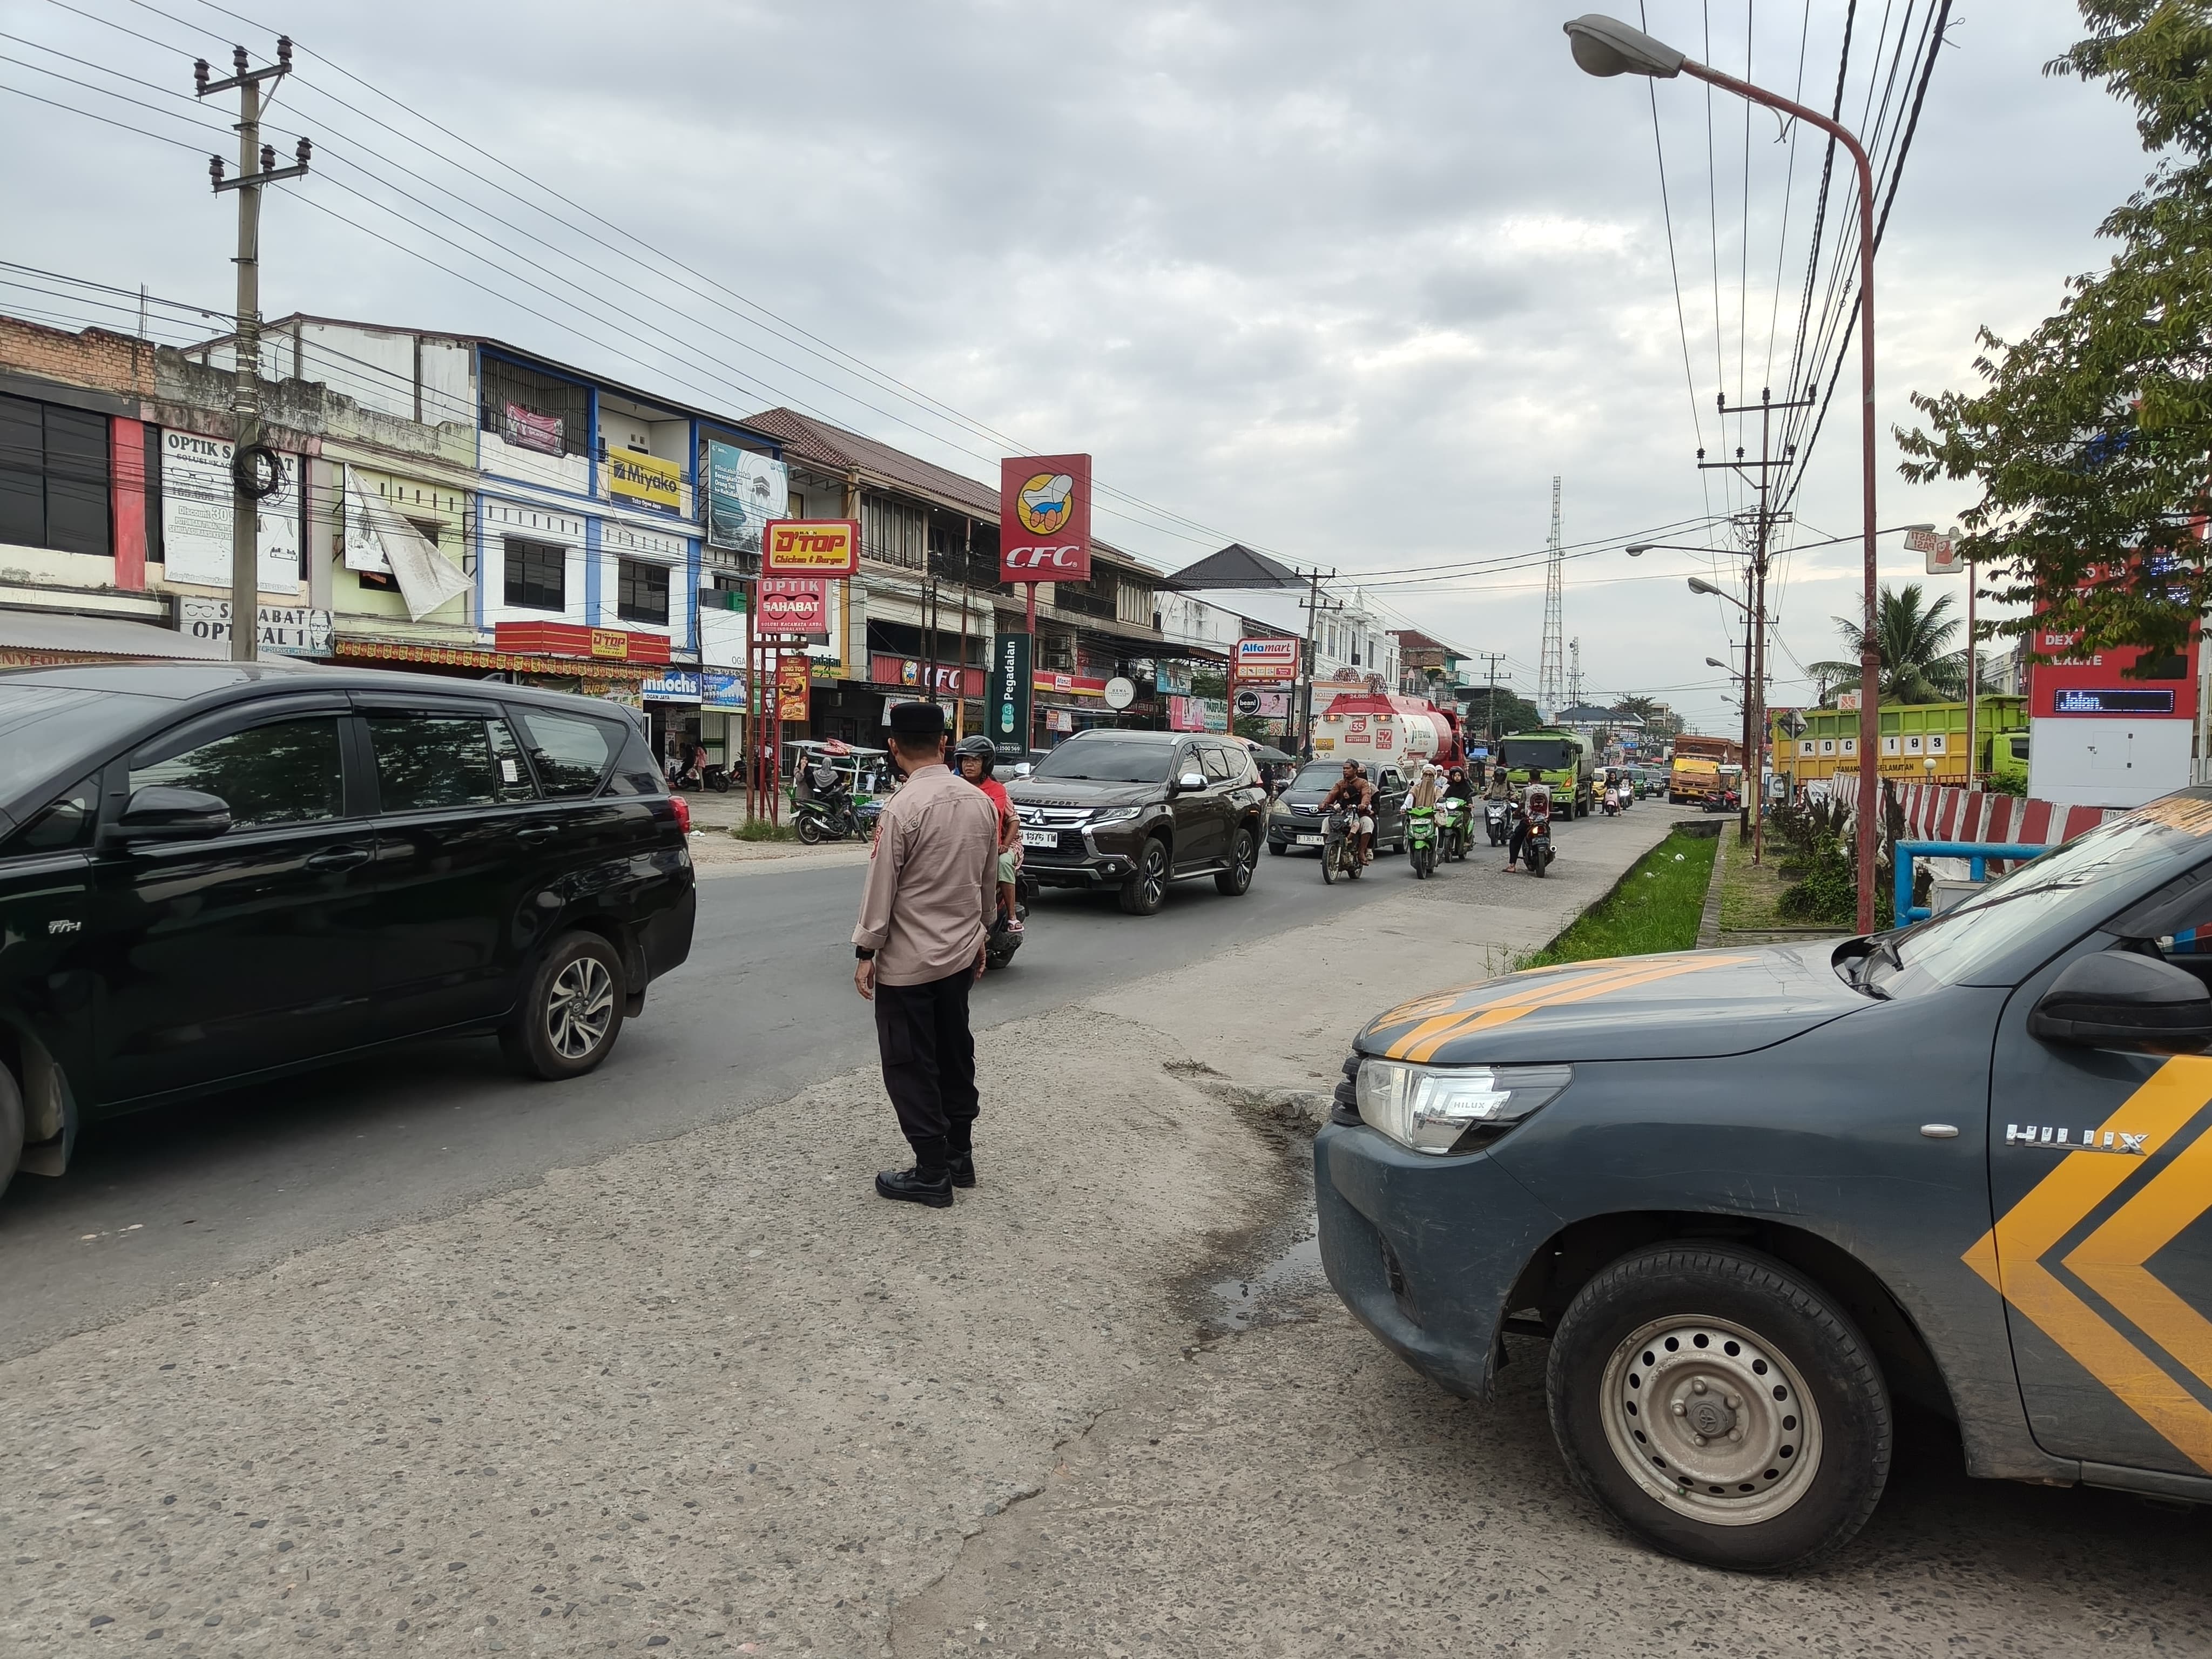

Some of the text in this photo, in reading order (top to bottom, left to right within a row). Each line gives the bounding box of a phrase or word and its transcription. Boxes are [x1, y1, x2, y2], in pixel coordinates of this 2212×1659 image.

[168, 434, 218, 457] OPTIK
[628, 463, 677, 493] Miyako
[211, 507, 228, 522] 30
[775, 531, 846, 552] D'TOP
[774, 555, 807, 563] Chicken
[815, 555, 845, 565] Burger
[1006, 545, 1080, 568] CFC
[763, 581, 819, 592] OPTIK
[763, 602, 820, 612] SAHABAT
[296, 629, 304, 646] 1
[2045, 635, 2074, 645] DEX
[1242, 643, 1291, 652] Alfamart
[1004, 641, 1016, 700] Pegadaian
[1377, 730, 1391, 743] 52
[2005, 1123, 2150, 1156] HILUX
